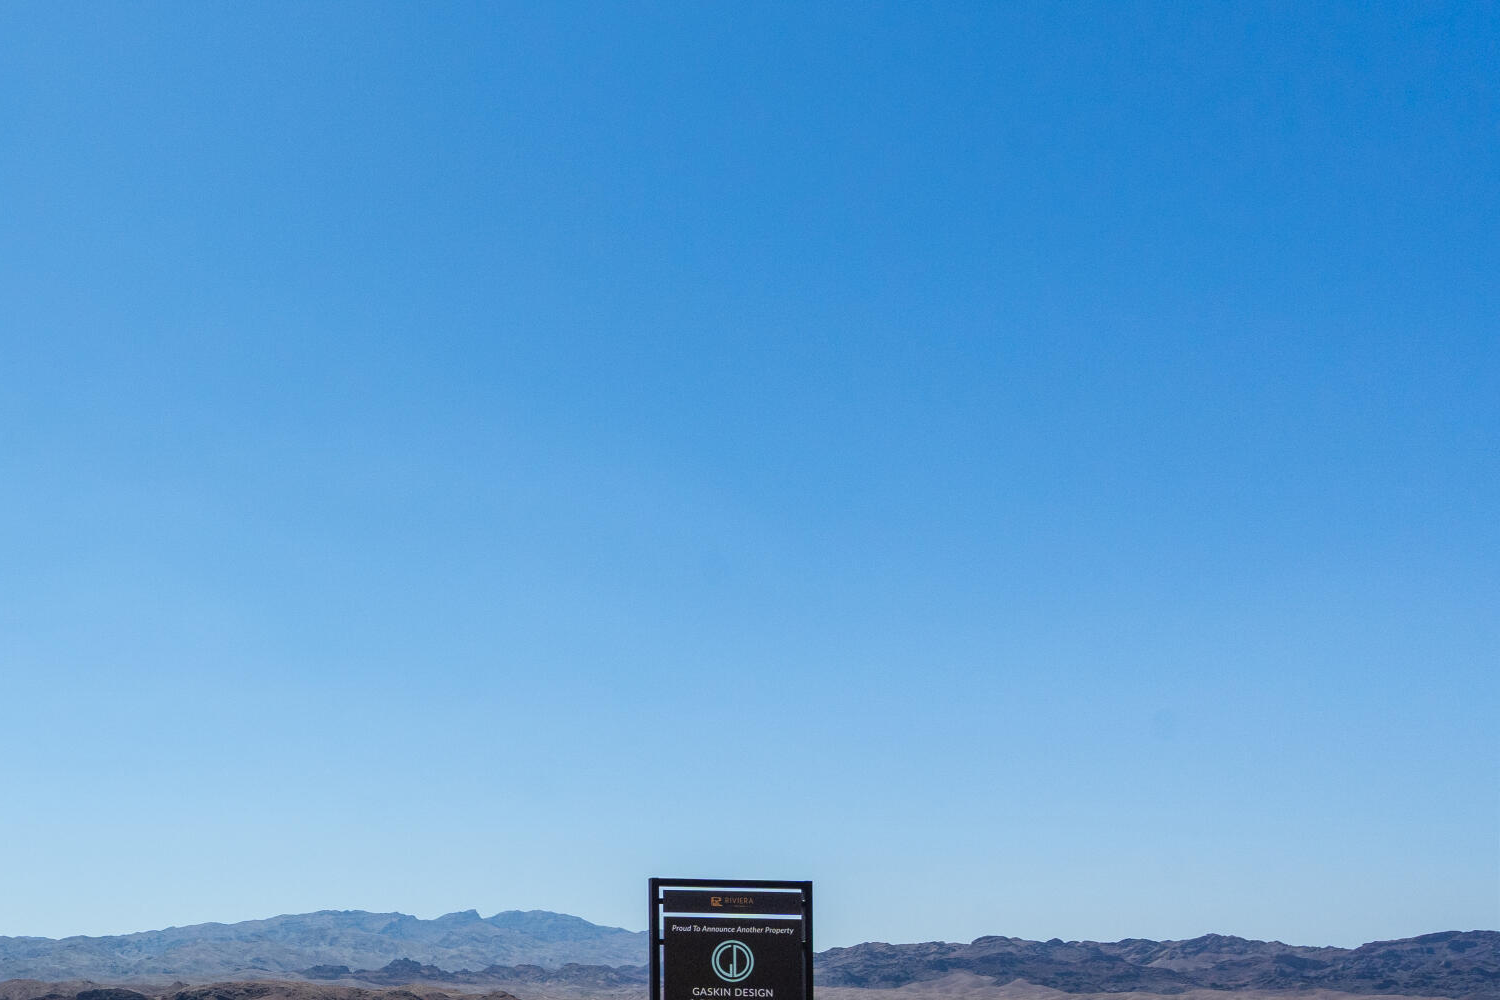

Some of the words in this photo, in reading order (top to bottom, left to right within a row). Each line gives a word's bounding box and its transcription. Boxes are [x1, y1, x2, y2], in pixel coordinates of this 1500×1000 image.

[724, 896, 754, 905] RIVIERA
[672, 924, 692, 932] Proud
[736, 926, 763, 934] Another
[764, 927, 794, 935] Property
[692, 987, 731, 996] GASKIN
[734, 988, 774, 997] DESIGN
